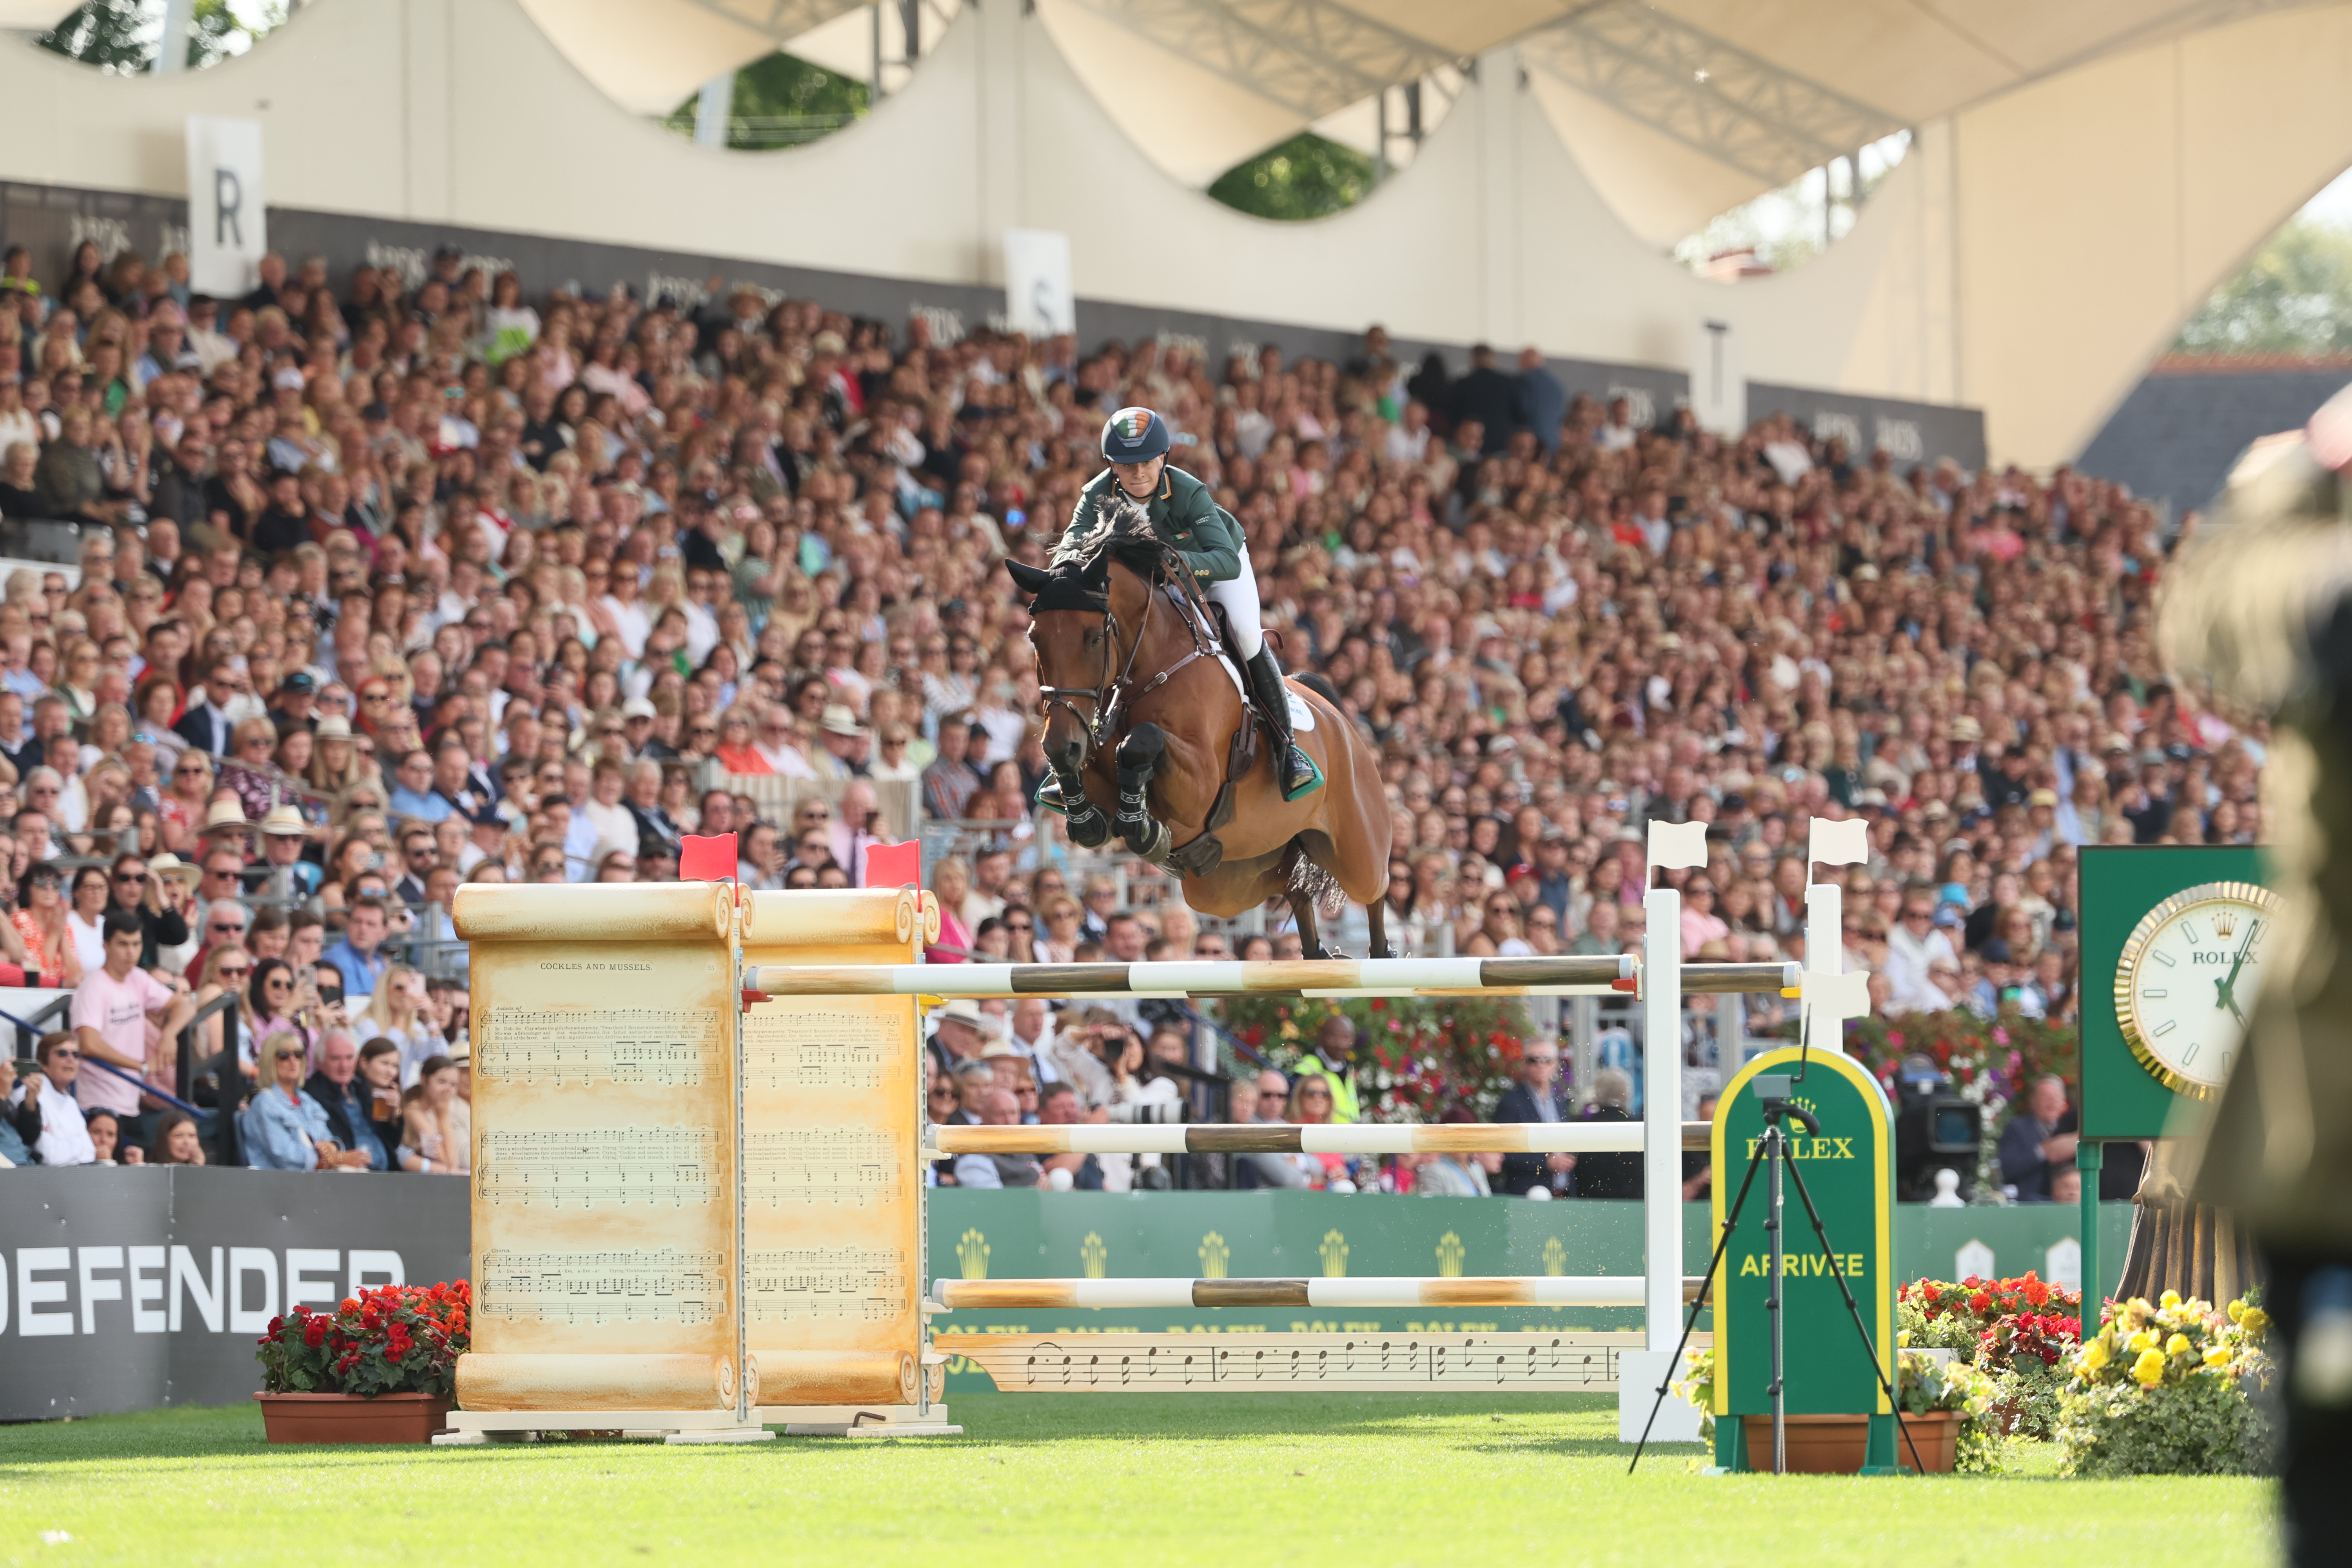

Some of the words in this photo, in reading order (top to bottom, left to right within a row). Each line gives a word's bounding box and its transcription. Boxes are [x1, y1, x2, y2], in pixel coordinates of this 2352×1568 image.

[214, 169, 243, 248] R
[1029, 276, 1055, 335] S
[1702, 318, 1730, 408] T
[1746, 1138, 1855, 1159] RLEX
[0, 1245, 405, 1336] EFENDE
